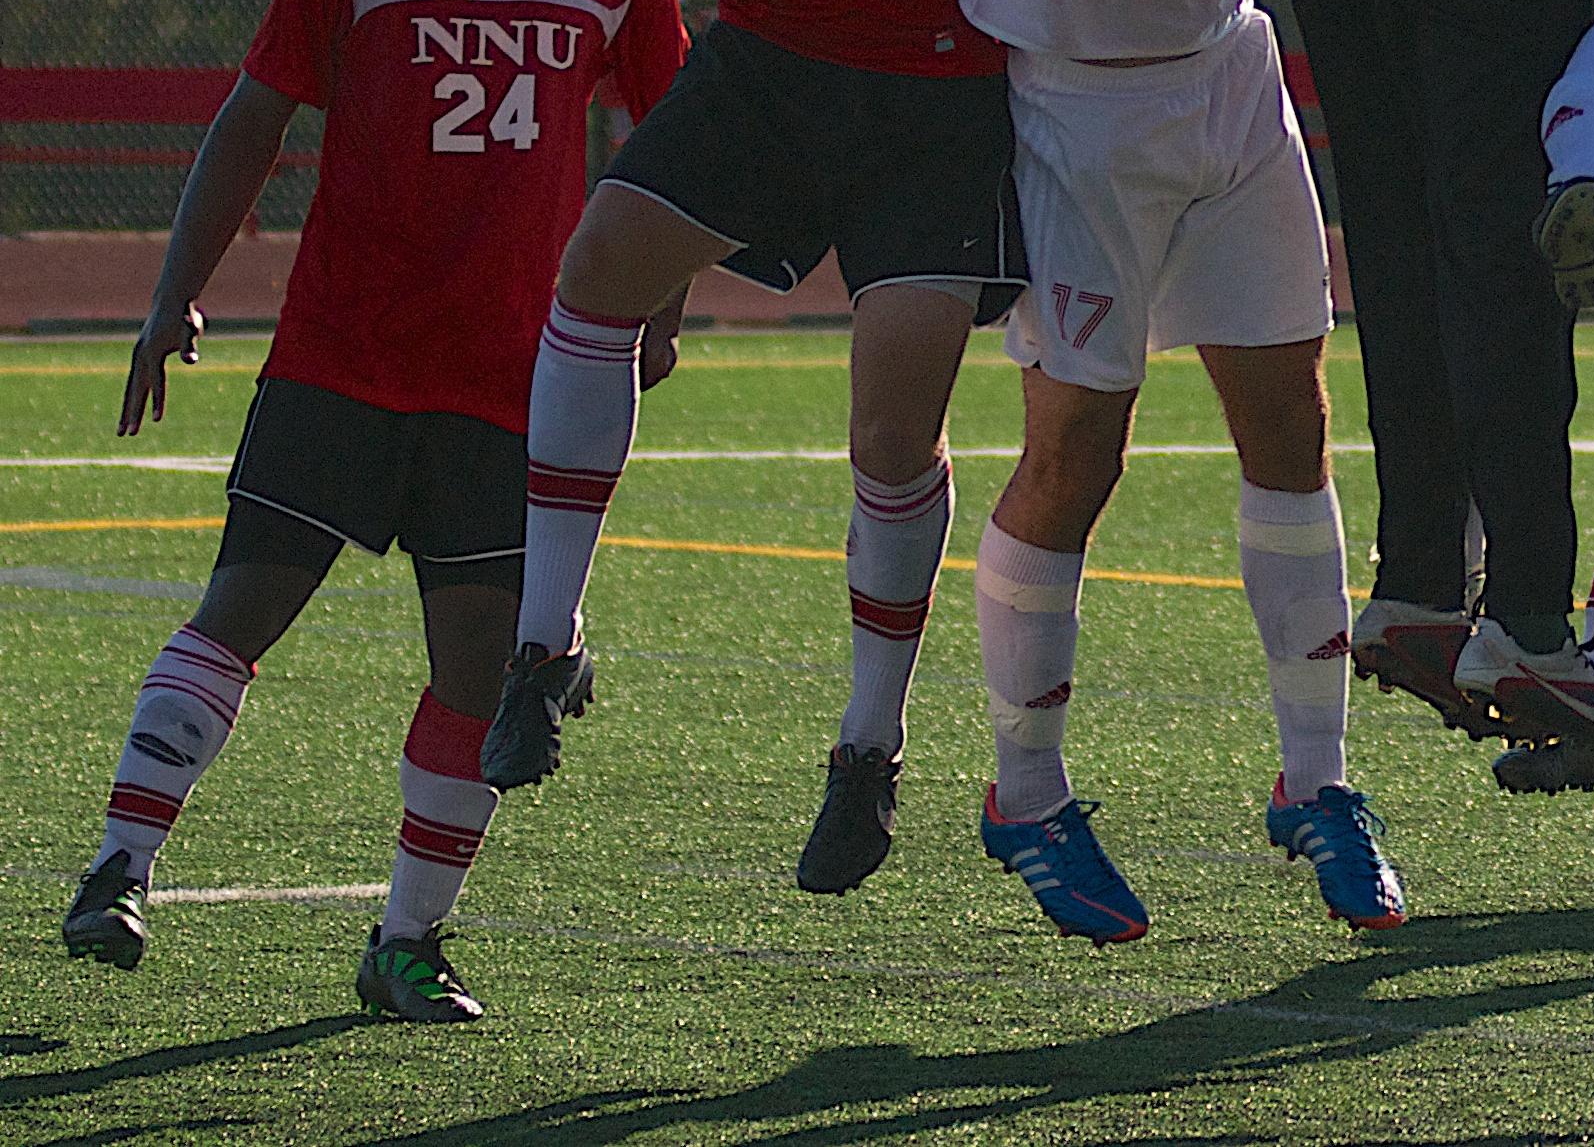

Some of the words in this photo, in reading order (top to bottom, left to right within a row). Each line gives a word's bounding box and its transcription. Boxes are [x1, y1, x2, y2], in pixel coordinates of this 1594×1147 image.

[410, 17, 583, 70] NNU
[432, 72, 540, 152] 24
[1051, 282, 1113, 350] 17
